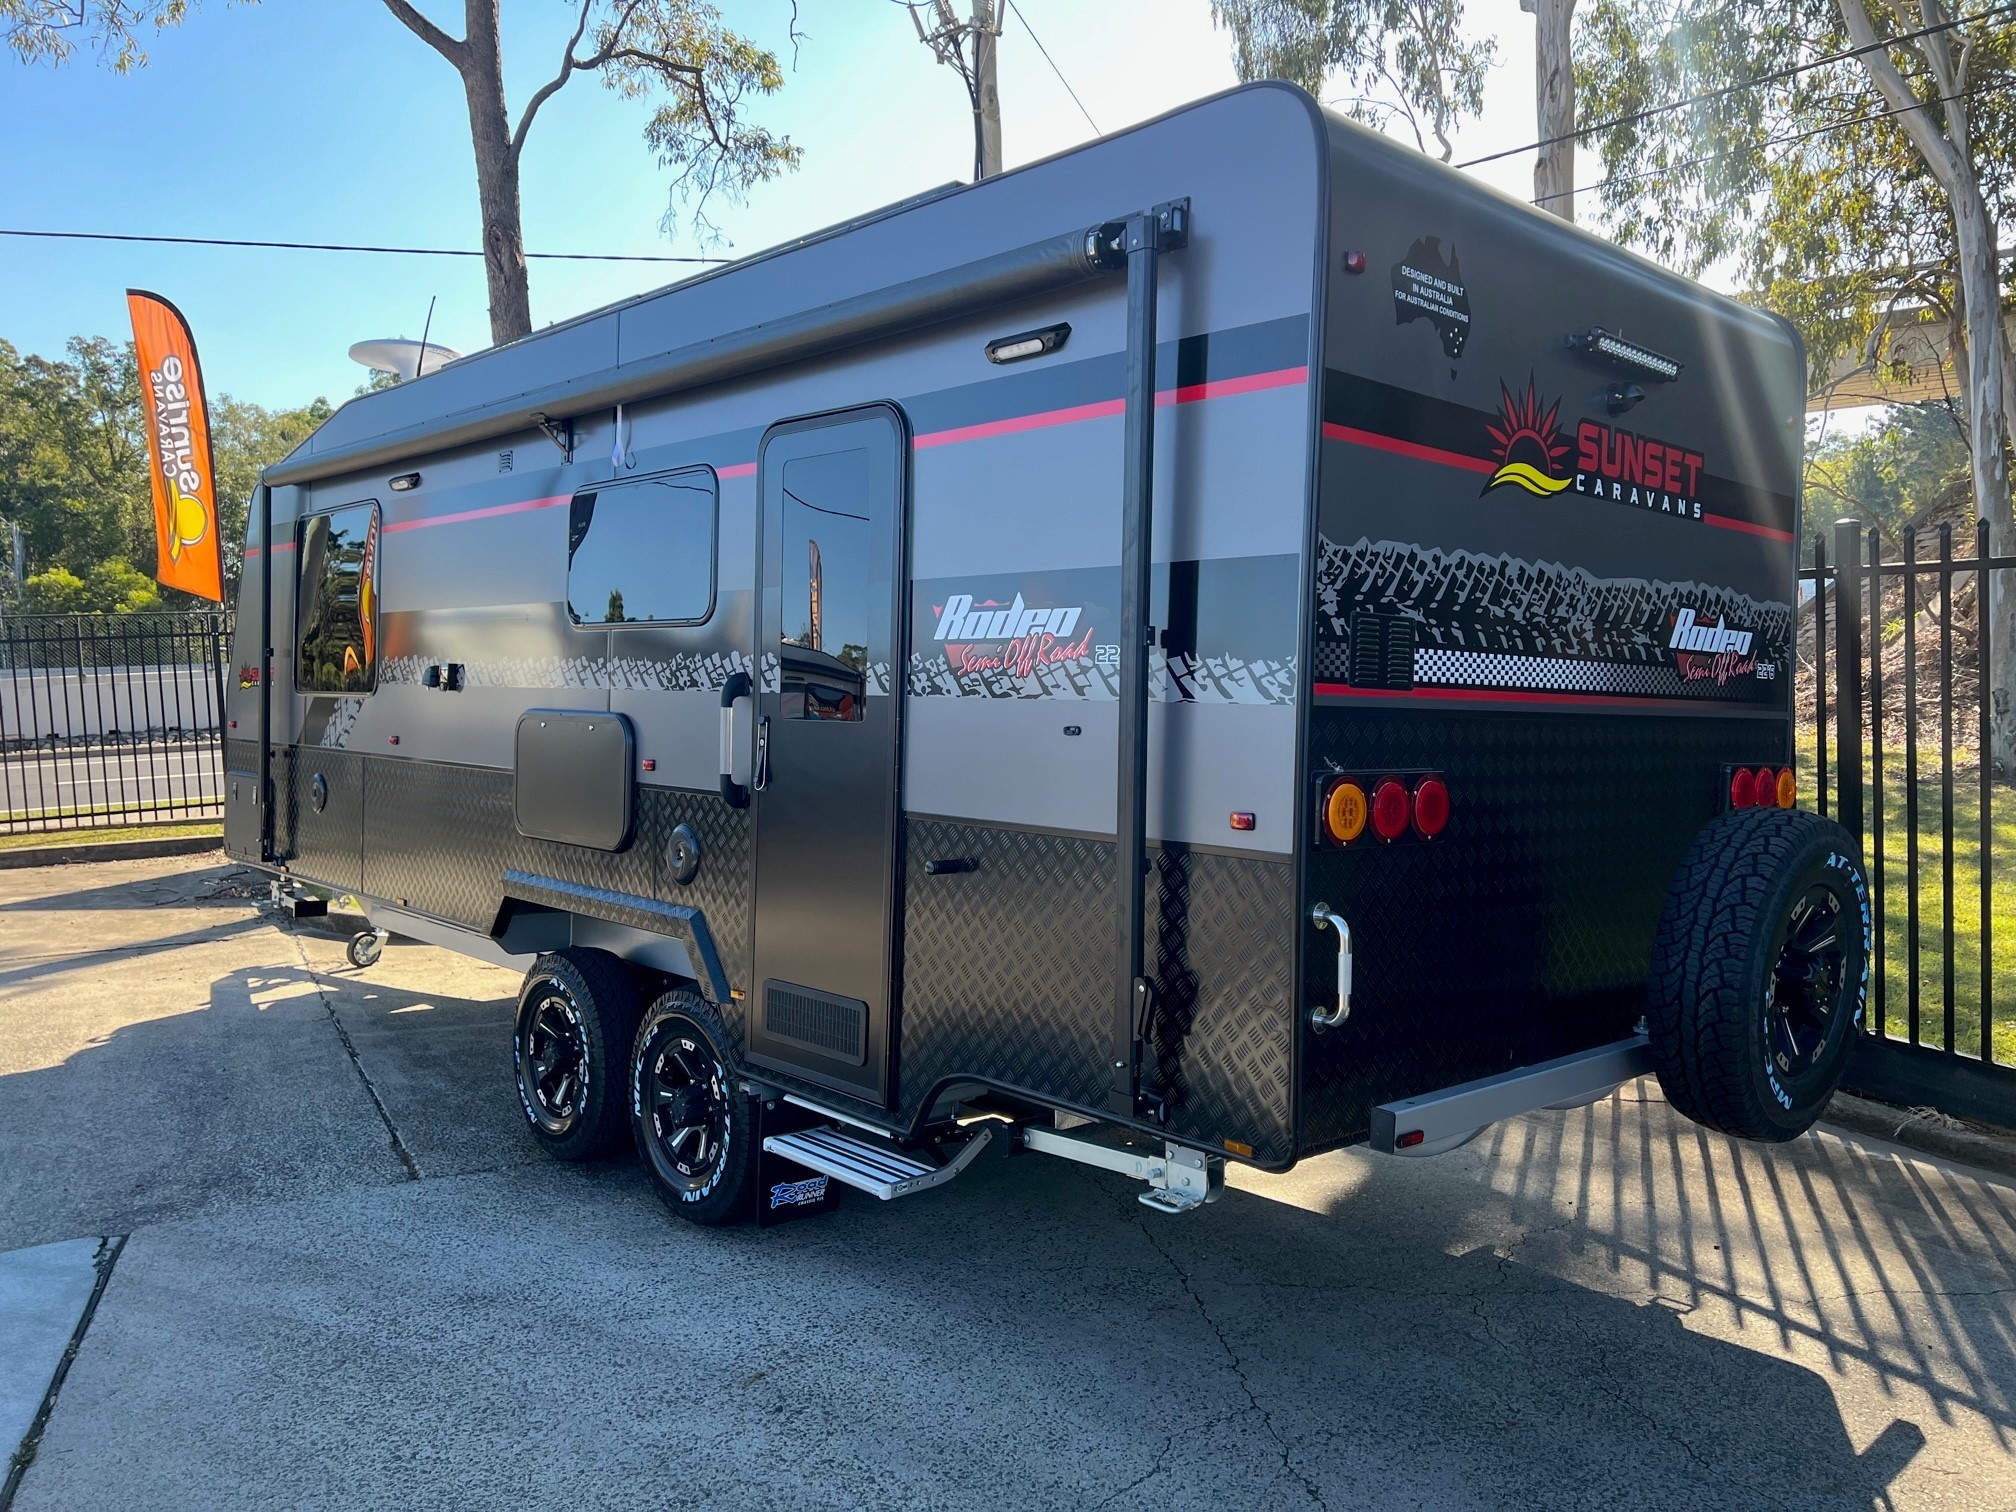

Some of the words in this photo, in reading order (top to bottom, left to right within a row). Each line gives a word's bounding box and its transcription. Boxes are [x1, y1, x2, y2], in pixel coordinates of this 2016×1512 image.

[1401, 265, 1433, 285] DESIGNED
[1433, 278, 1447, 291] AND
[1447, 286, 1464, 297] BUILT
[1412, 283, 1419, 294] IN
[1420, 286, 1454, 306] AUSTRALIA
[1395, 290, 1407, 301] FOR
[1407, 296, 1439, 313] AUSTRALIAN
[1439, 306, 1469, 323] CONDITIONS
[1577, 421, 1703, 497] SUNSET
[1576, 474, 1702, 518] CARAVANS
[933, 591, 1083, 641] Rodeo
[1668, 607, 1754, 656] Rodeo
[957, 643, 1002, 677] Semi
[1004, 631, 1041, 678] Off
[1036, 626, 1095, 666] Road
[1684, 655, 1712, 683] Semi
[1711, 652, 1732, 687] Off
[1729, 649, 1758, 678] Road
[770, 1174, 829, 1209] Road
[796, 1188, 826, 1202] RUNNER
